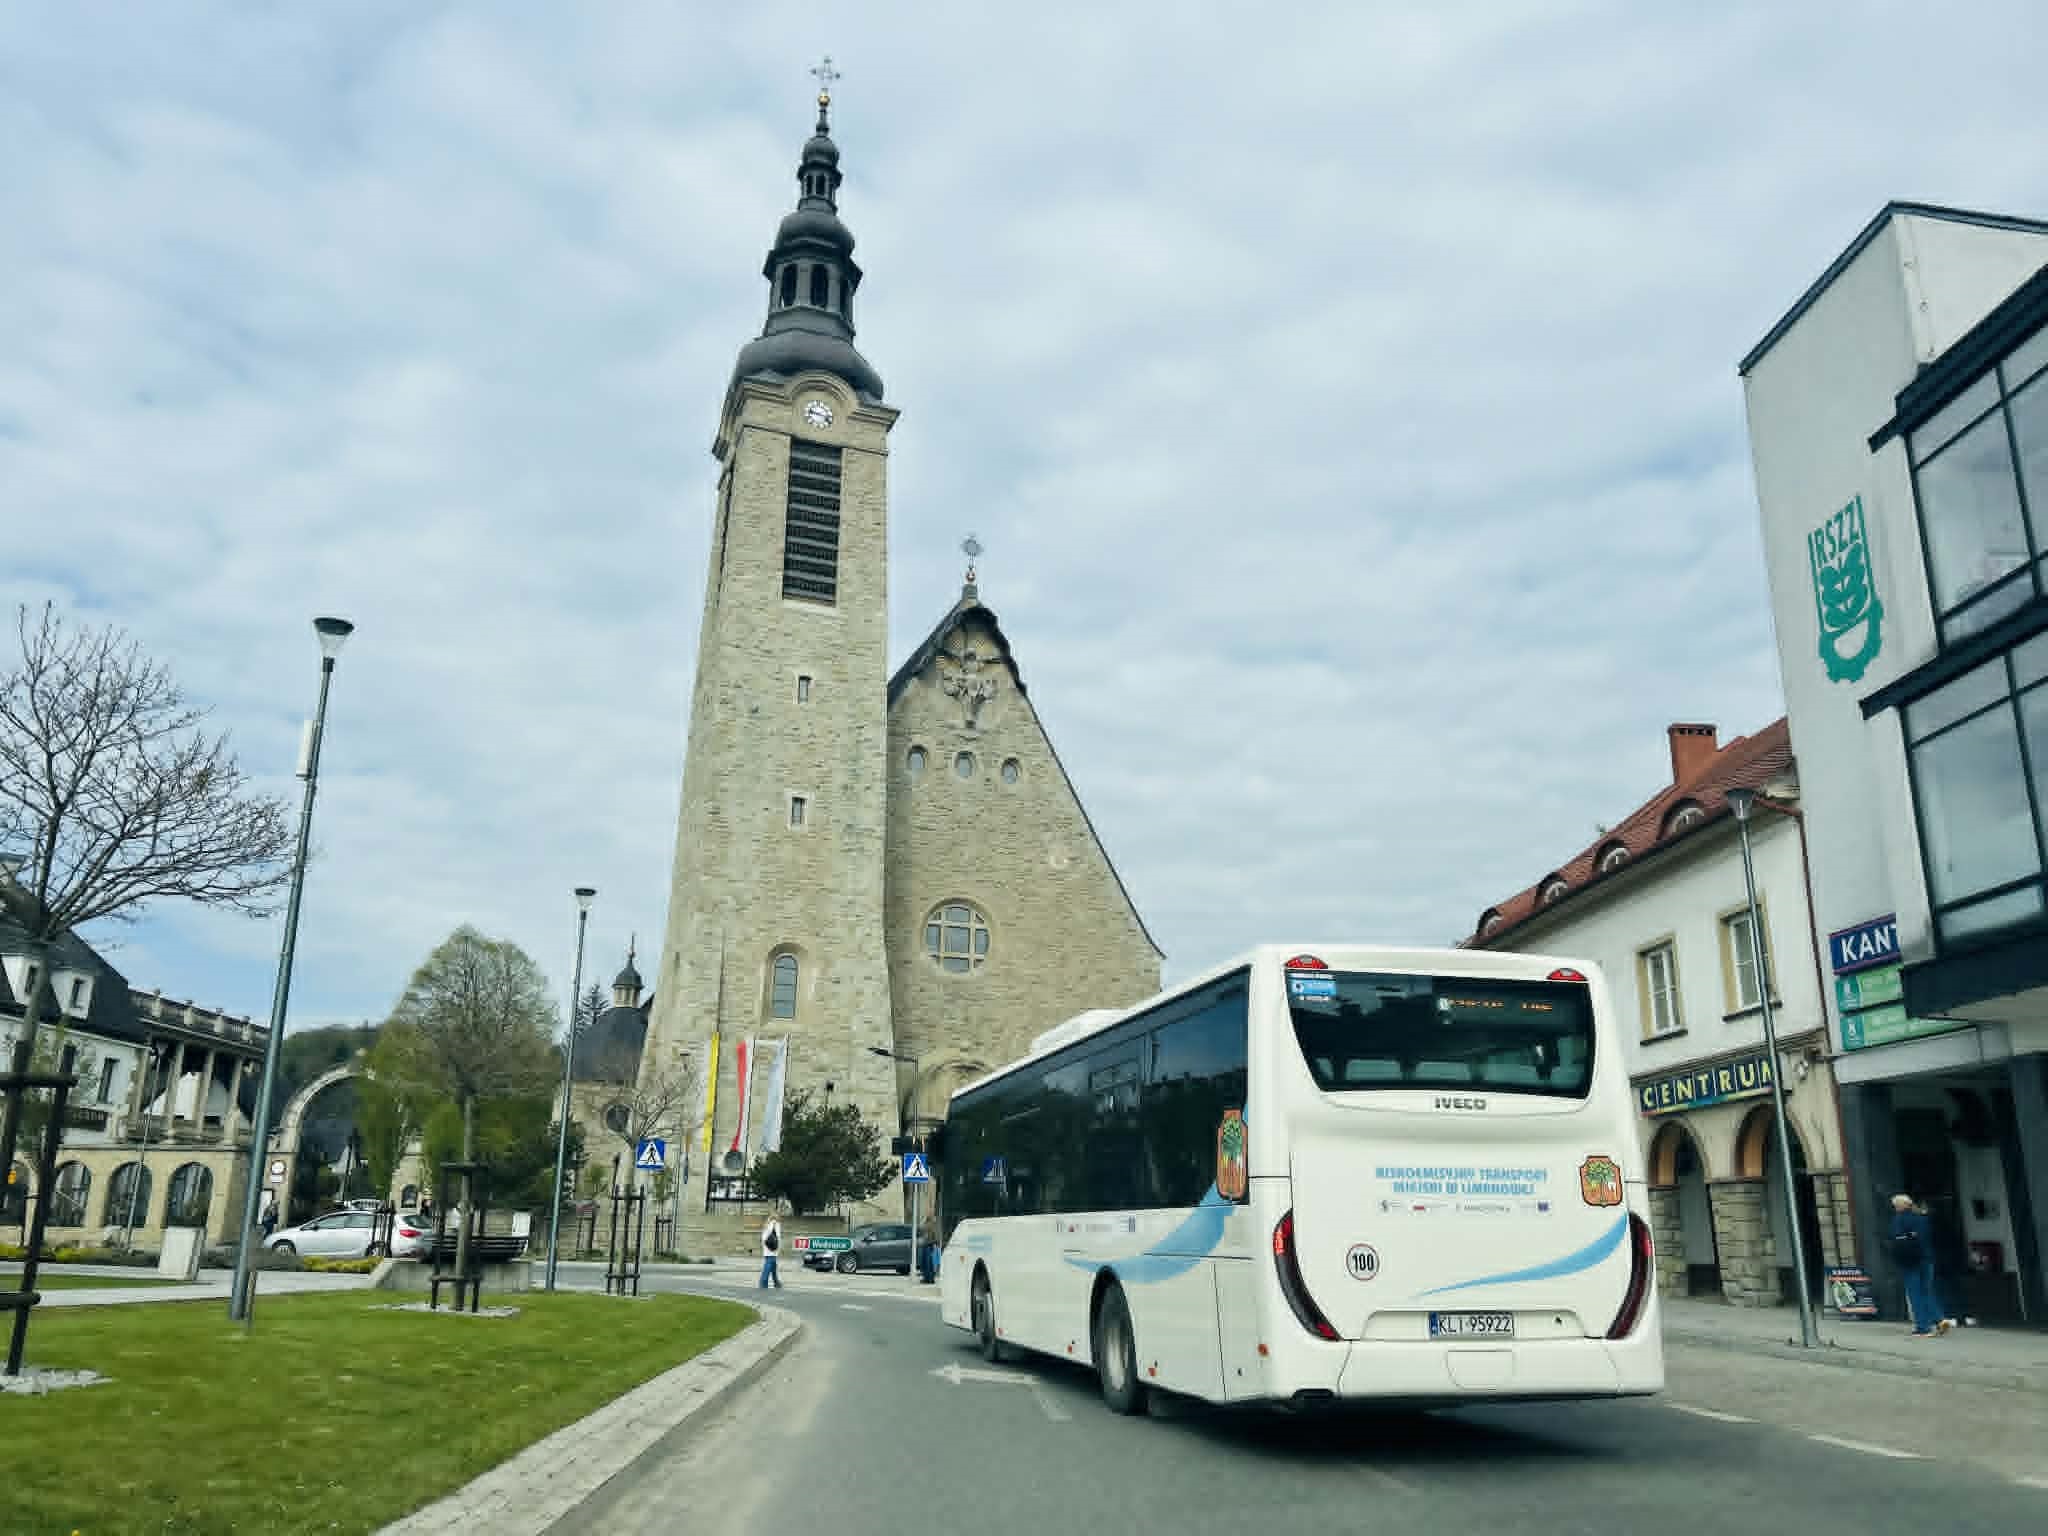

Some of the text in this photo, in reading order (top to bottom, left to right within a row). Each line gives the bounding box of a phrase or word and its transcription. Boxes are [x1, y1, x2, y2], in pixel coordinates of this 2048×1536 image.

[1435, 1096, 1487, 1110] IVECO
[1351, 1253, 1375, 1272] 100
[1469, 1315, 1511, 1333] 95922
